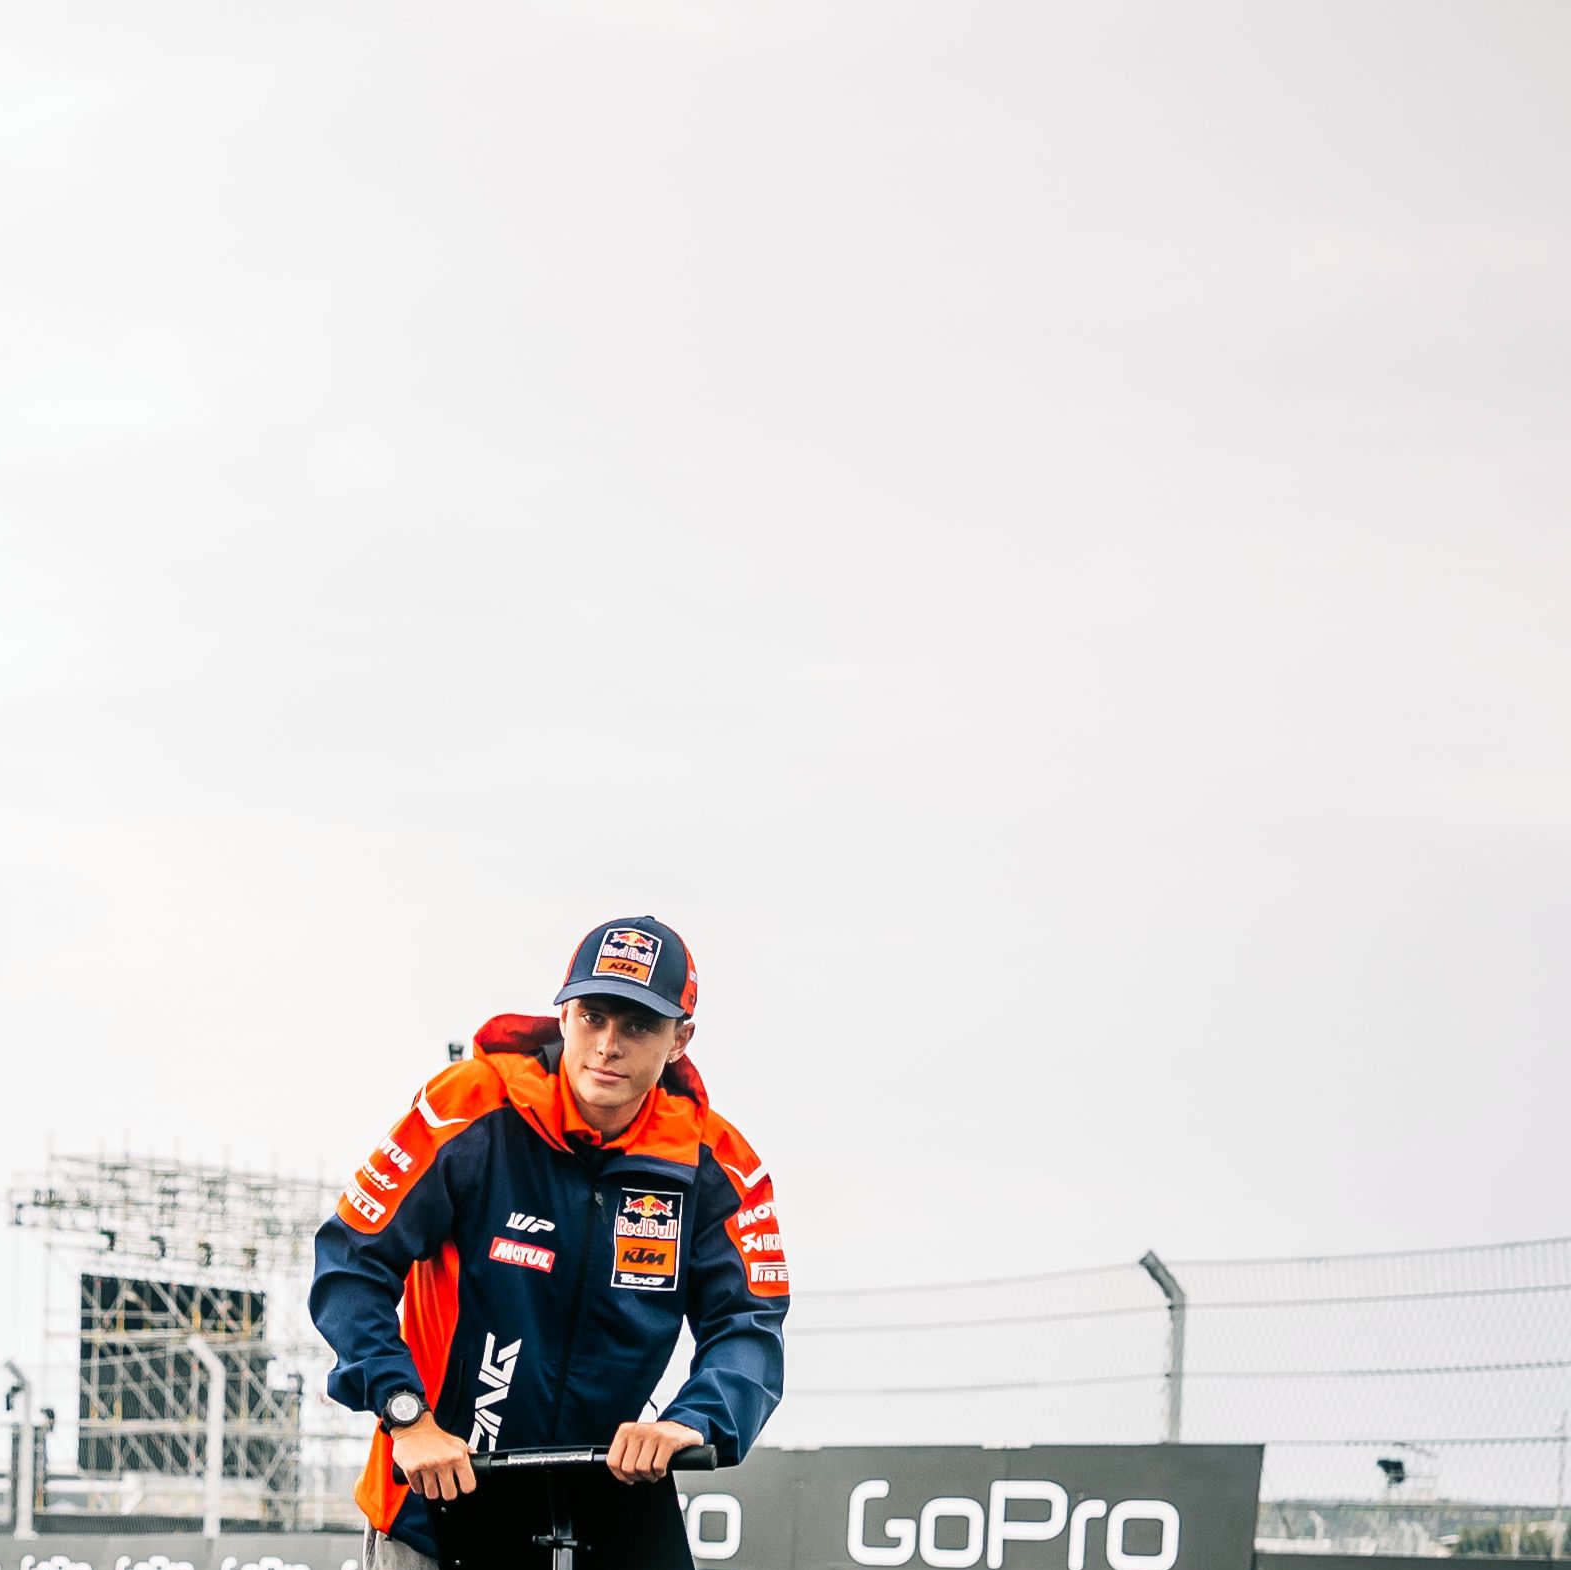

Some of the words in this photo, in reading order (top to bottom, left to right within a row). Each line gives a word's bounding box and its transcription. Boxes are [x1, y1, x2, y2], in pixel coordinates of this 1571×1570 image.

[506, 1212, 555, 1233] WP
[617, 1216, 648, 1237] Red
[648, 1218, 677, 1239] Bull
[494, 1241, 550, 1269] MOTUL
[622, 1247, 666, 1266] KTM
[750, 1262, 789, 1283] PIRE
